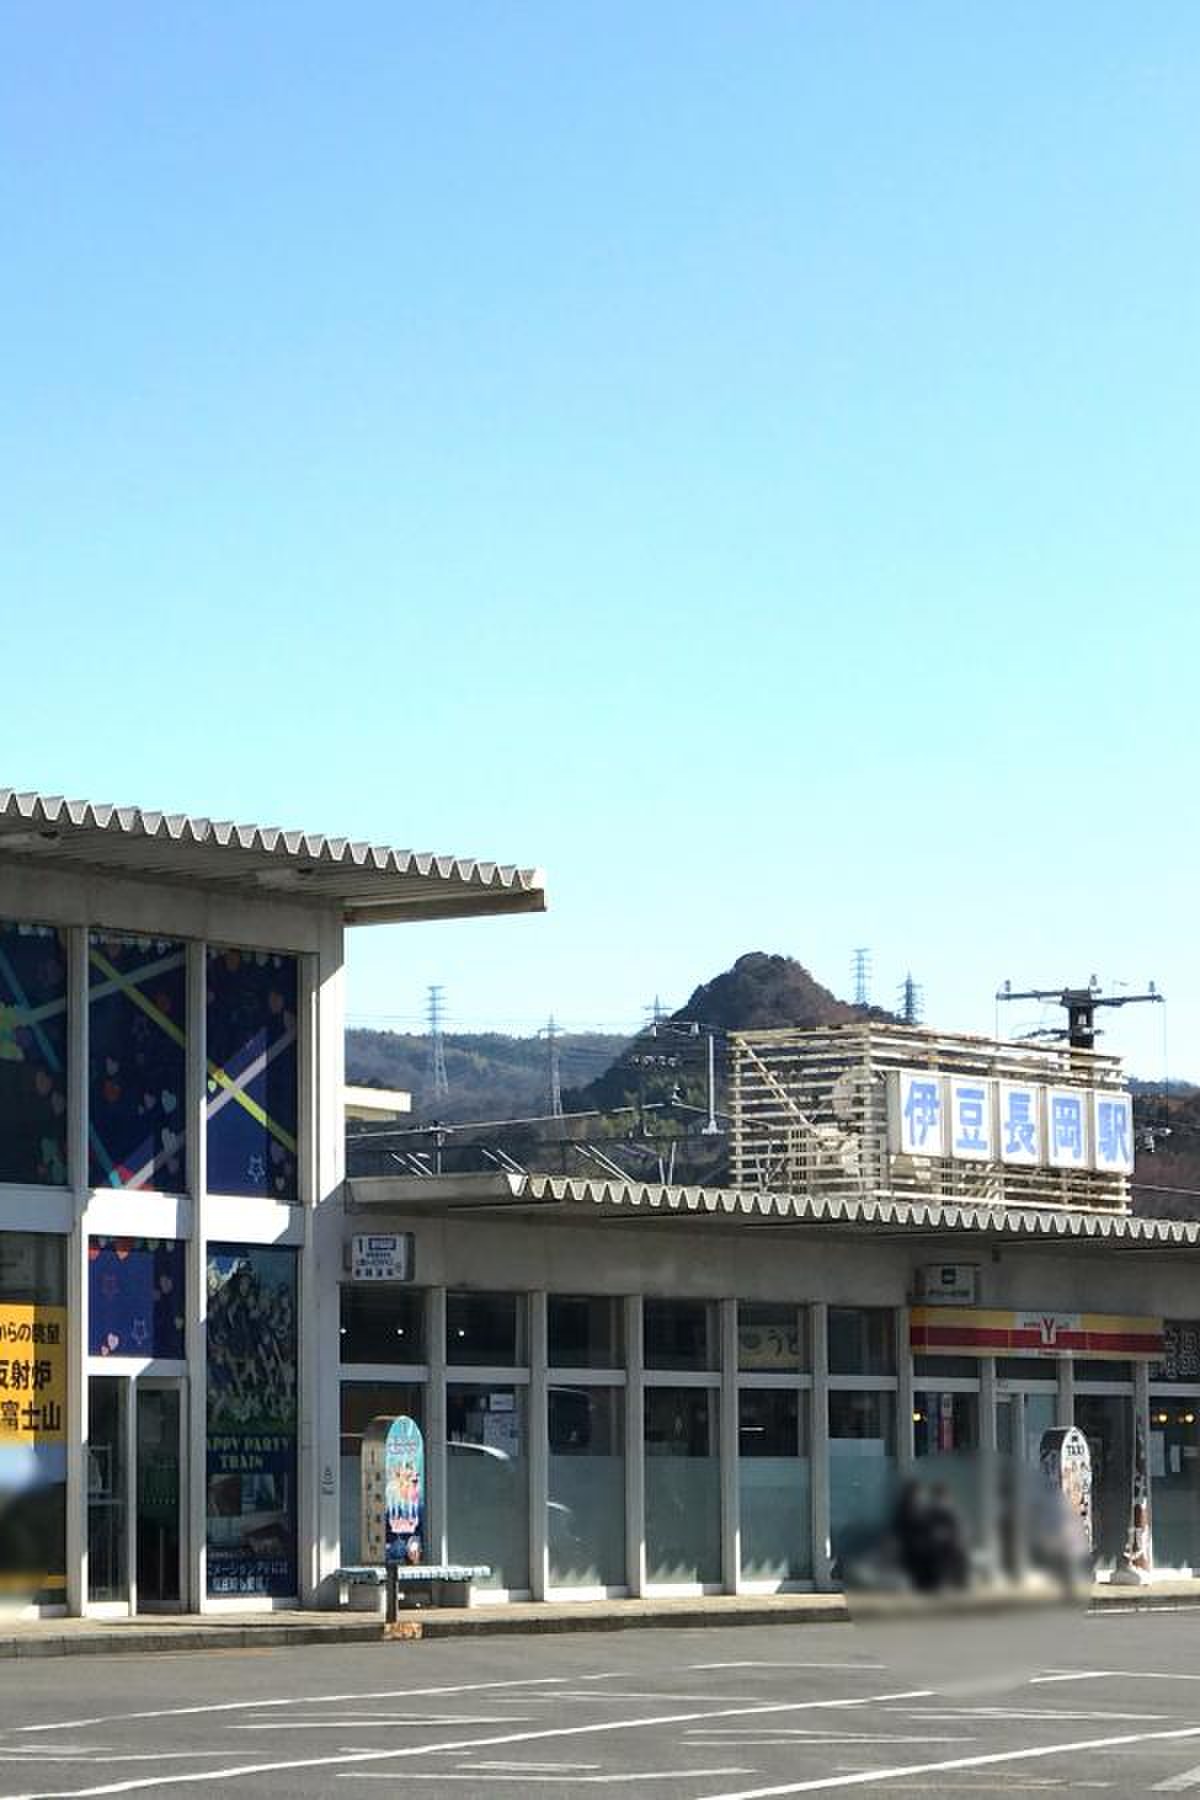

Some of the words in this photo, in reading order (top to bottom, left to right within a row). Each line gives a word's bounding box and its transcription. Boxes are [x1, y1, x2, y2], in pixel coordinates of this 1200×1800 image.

[905, 1081, 1131, 1163] 伊豆長岡駅
